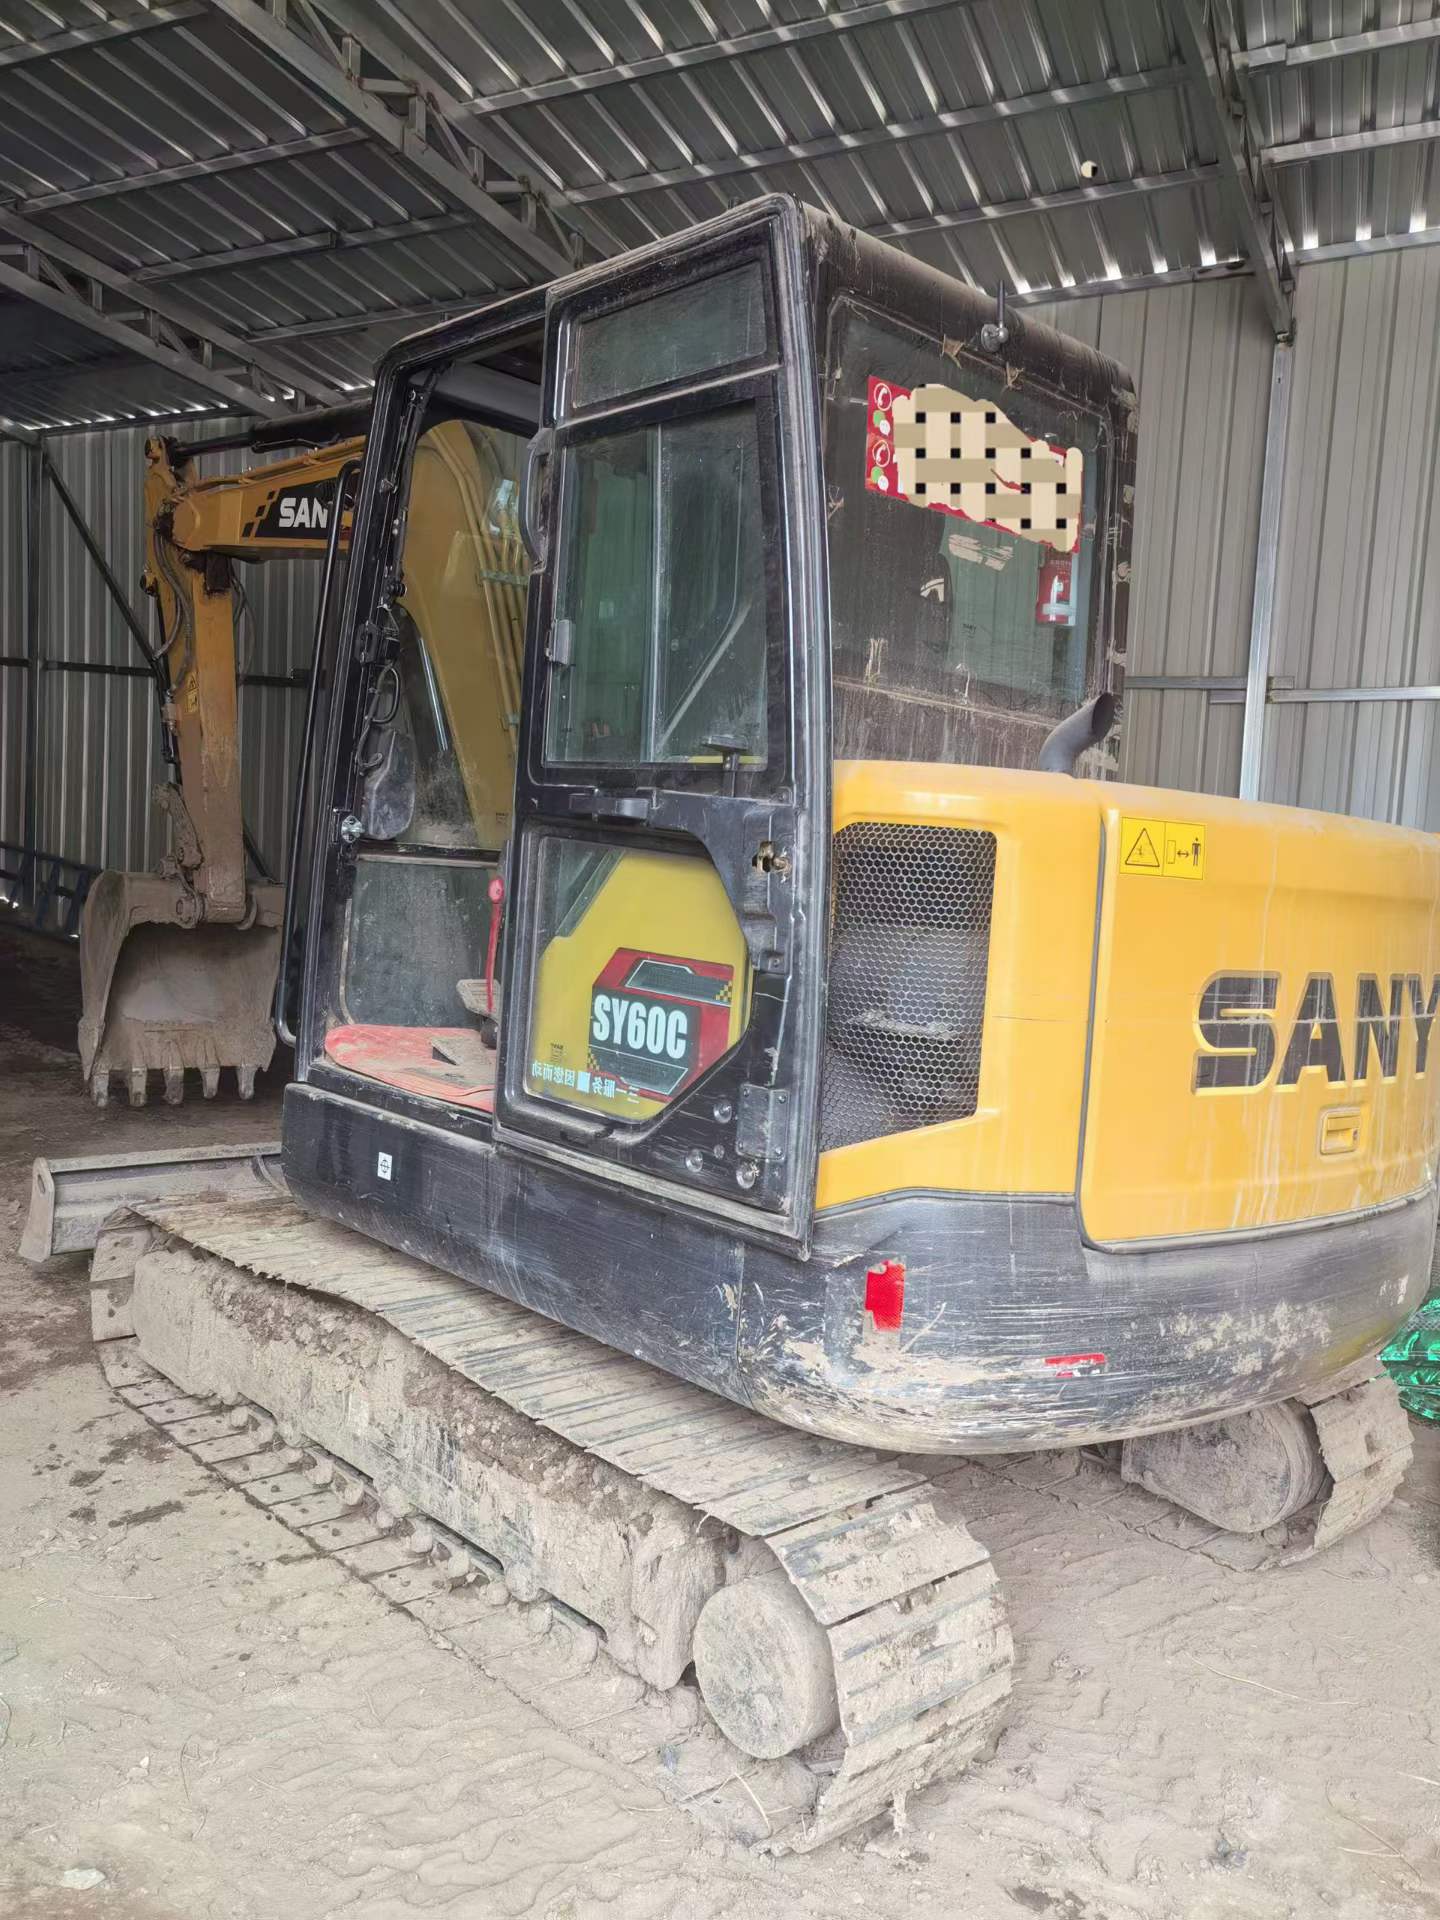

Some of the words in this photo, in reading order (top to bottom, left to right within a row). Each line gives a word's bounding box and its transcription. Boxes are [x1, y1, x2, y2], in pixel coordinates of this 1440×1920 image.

[279, 497, 328, 529] SAN
[592, 994, 688, 1060] SY60C
[1192, 970, 1440, 1096] SANY
